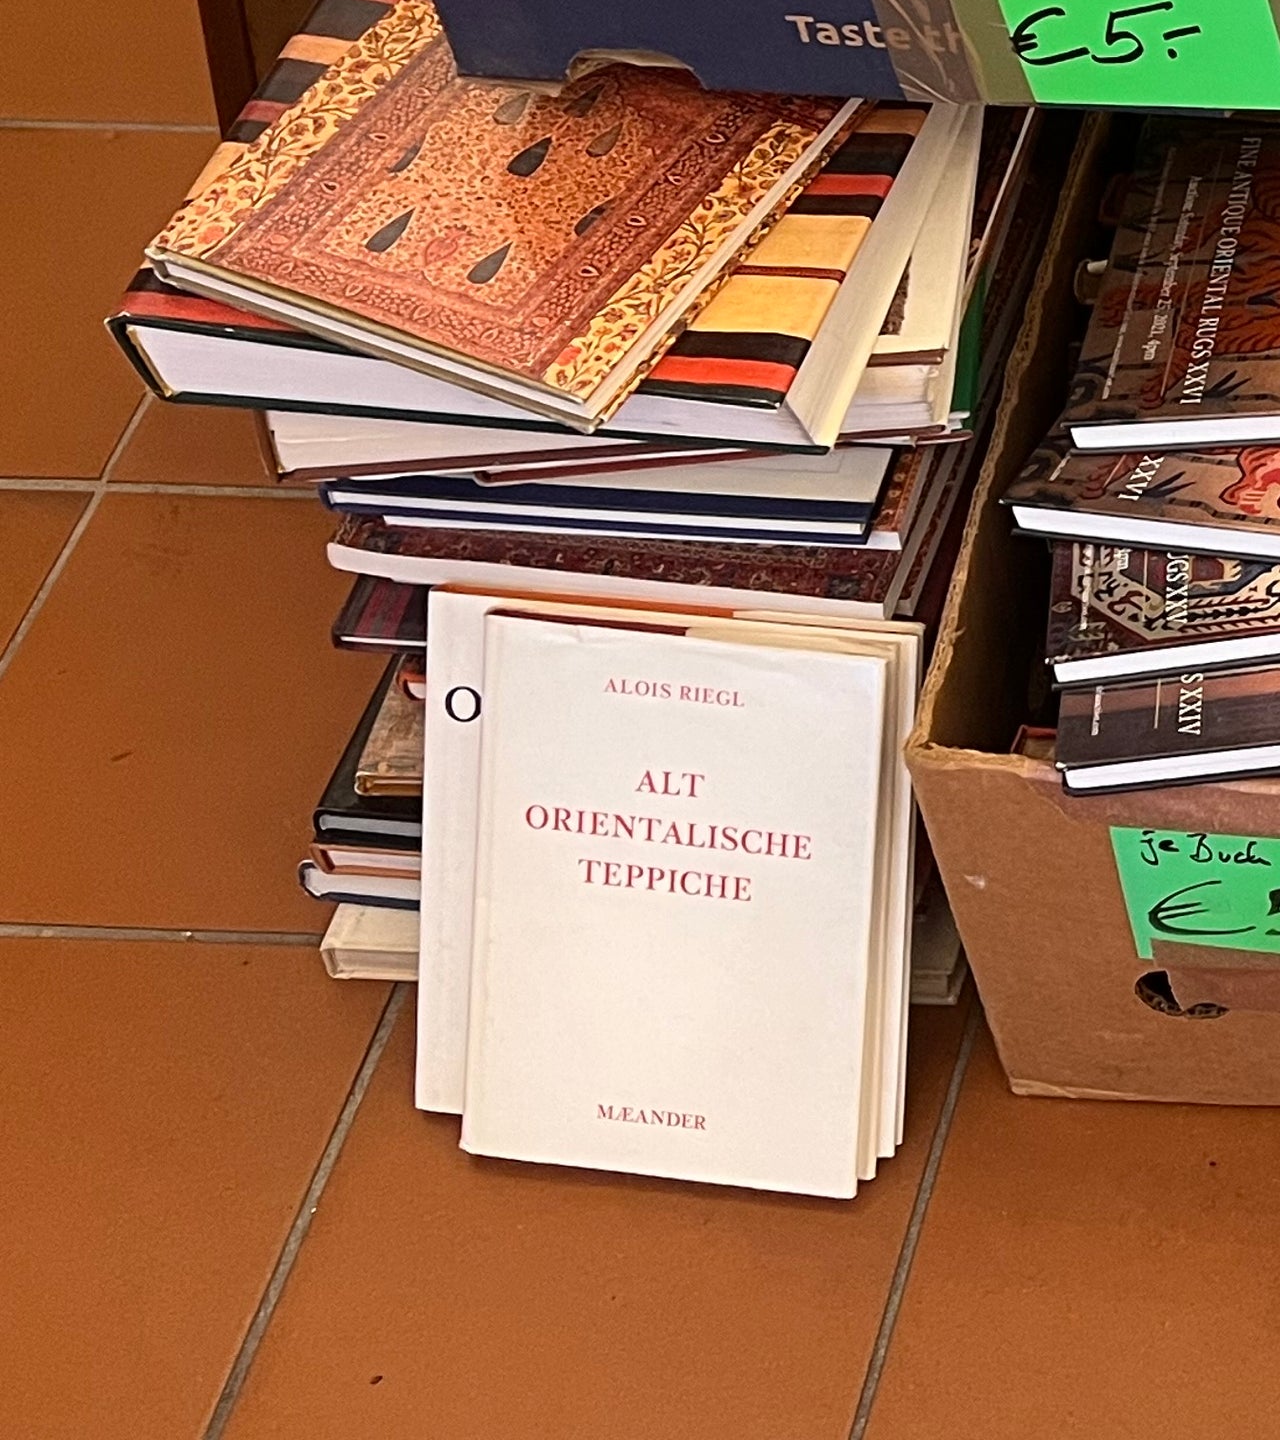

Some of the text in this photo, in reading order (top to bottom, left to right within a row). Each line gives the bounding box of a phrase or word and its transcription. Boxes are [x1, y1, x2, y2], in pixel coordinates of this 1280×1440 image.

[785, 14, 910, 50] Taste
[1178, 137, 1262, 406] FINE ANTIQUE ORIENTAL RUGS XXVI
[1119, 454, 1164, 502] XXVI
[604, 677, 745, 708] ALOIS RIEGL
[1178, 688, 1203, 735] XXIV
[635, 770, 705, 798] ALT
[525, 804, 812, 860] ORIENTALISCHE
[1140, 830, 1272, 866] je Buch
[578, 858, 752, 902] TEPPICHE
